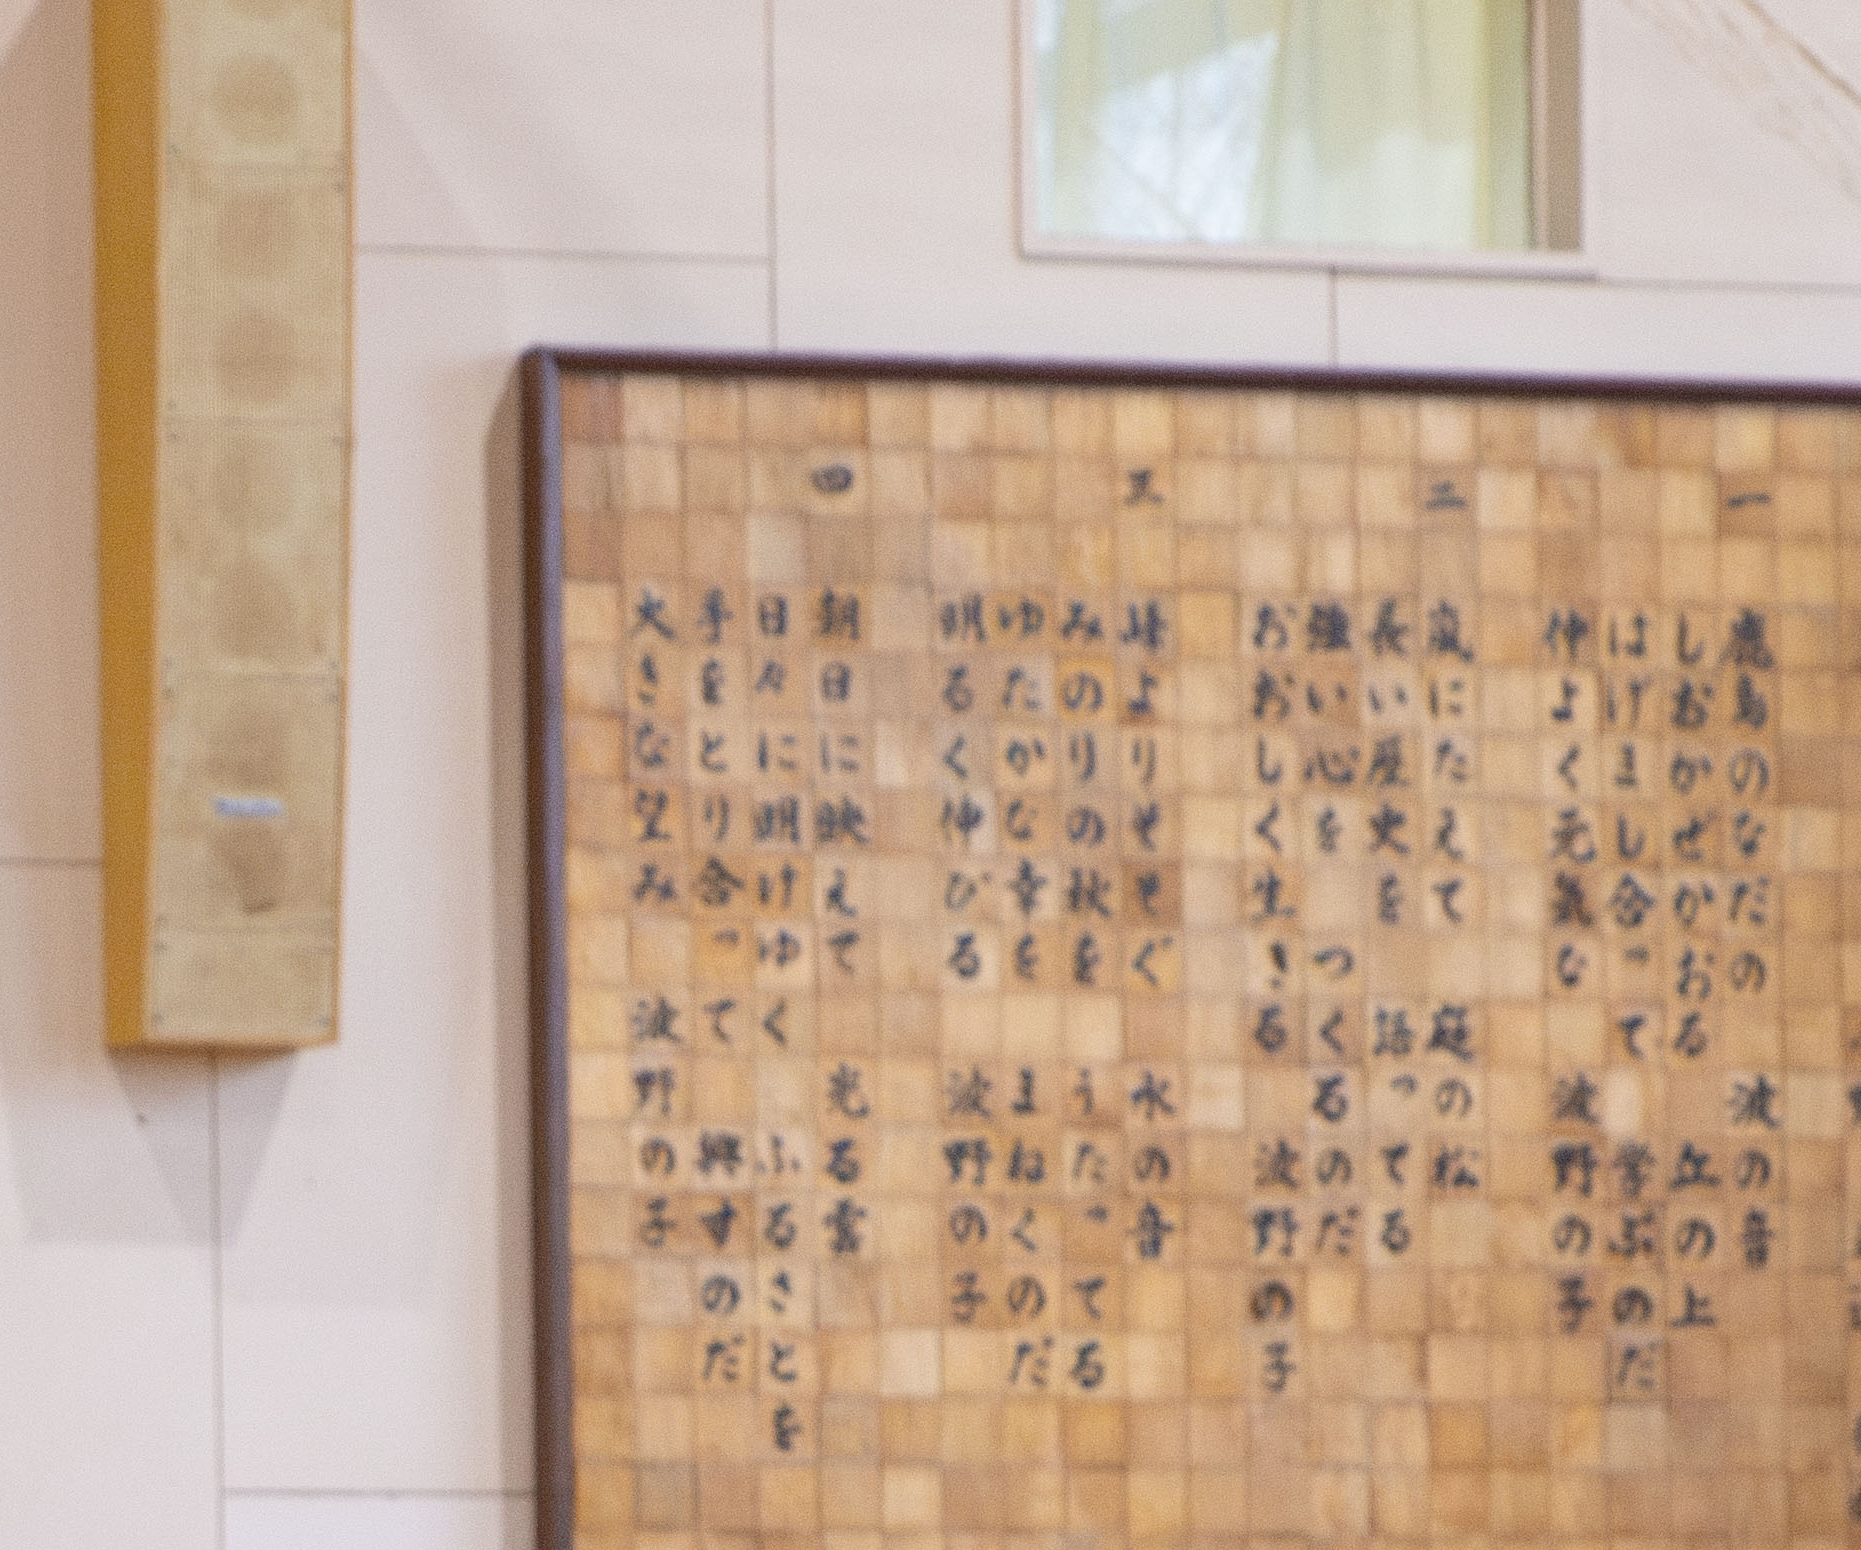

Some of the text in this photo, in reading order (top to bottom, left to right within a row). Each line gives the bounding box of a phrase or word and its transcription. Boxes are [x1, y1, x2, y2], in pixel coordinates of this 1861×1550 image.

[940, 595, 992, 1323] 明るく伸びる 波野の子
[998, 600, 1055, 1390] ゆたかな幸を まねくのだ
[1060, 602, 1112, 1393] みのりの秋を うたってる
[1311, 948, 1359, 1255] つくるのだ
[1426, 1003, 1479, 1189] 庭の松
[1545, 611, 1599, 1332] 仲よく元気な 波野の子
[1605, 613, 1659, 1390] はげまし合って 学ぶのだ
[631, 996, 679, 1249] 波野の子
[1129, 1072, 1174, 1259] 水の音
[1249, 1139, 1299, 1393] 波野の子
[1373, 1009, 1417, 1255] 語ってる
[1731, 1072, 1783, 1270] 波の音
[754, 1132, 802, 1454] ふるさとを
